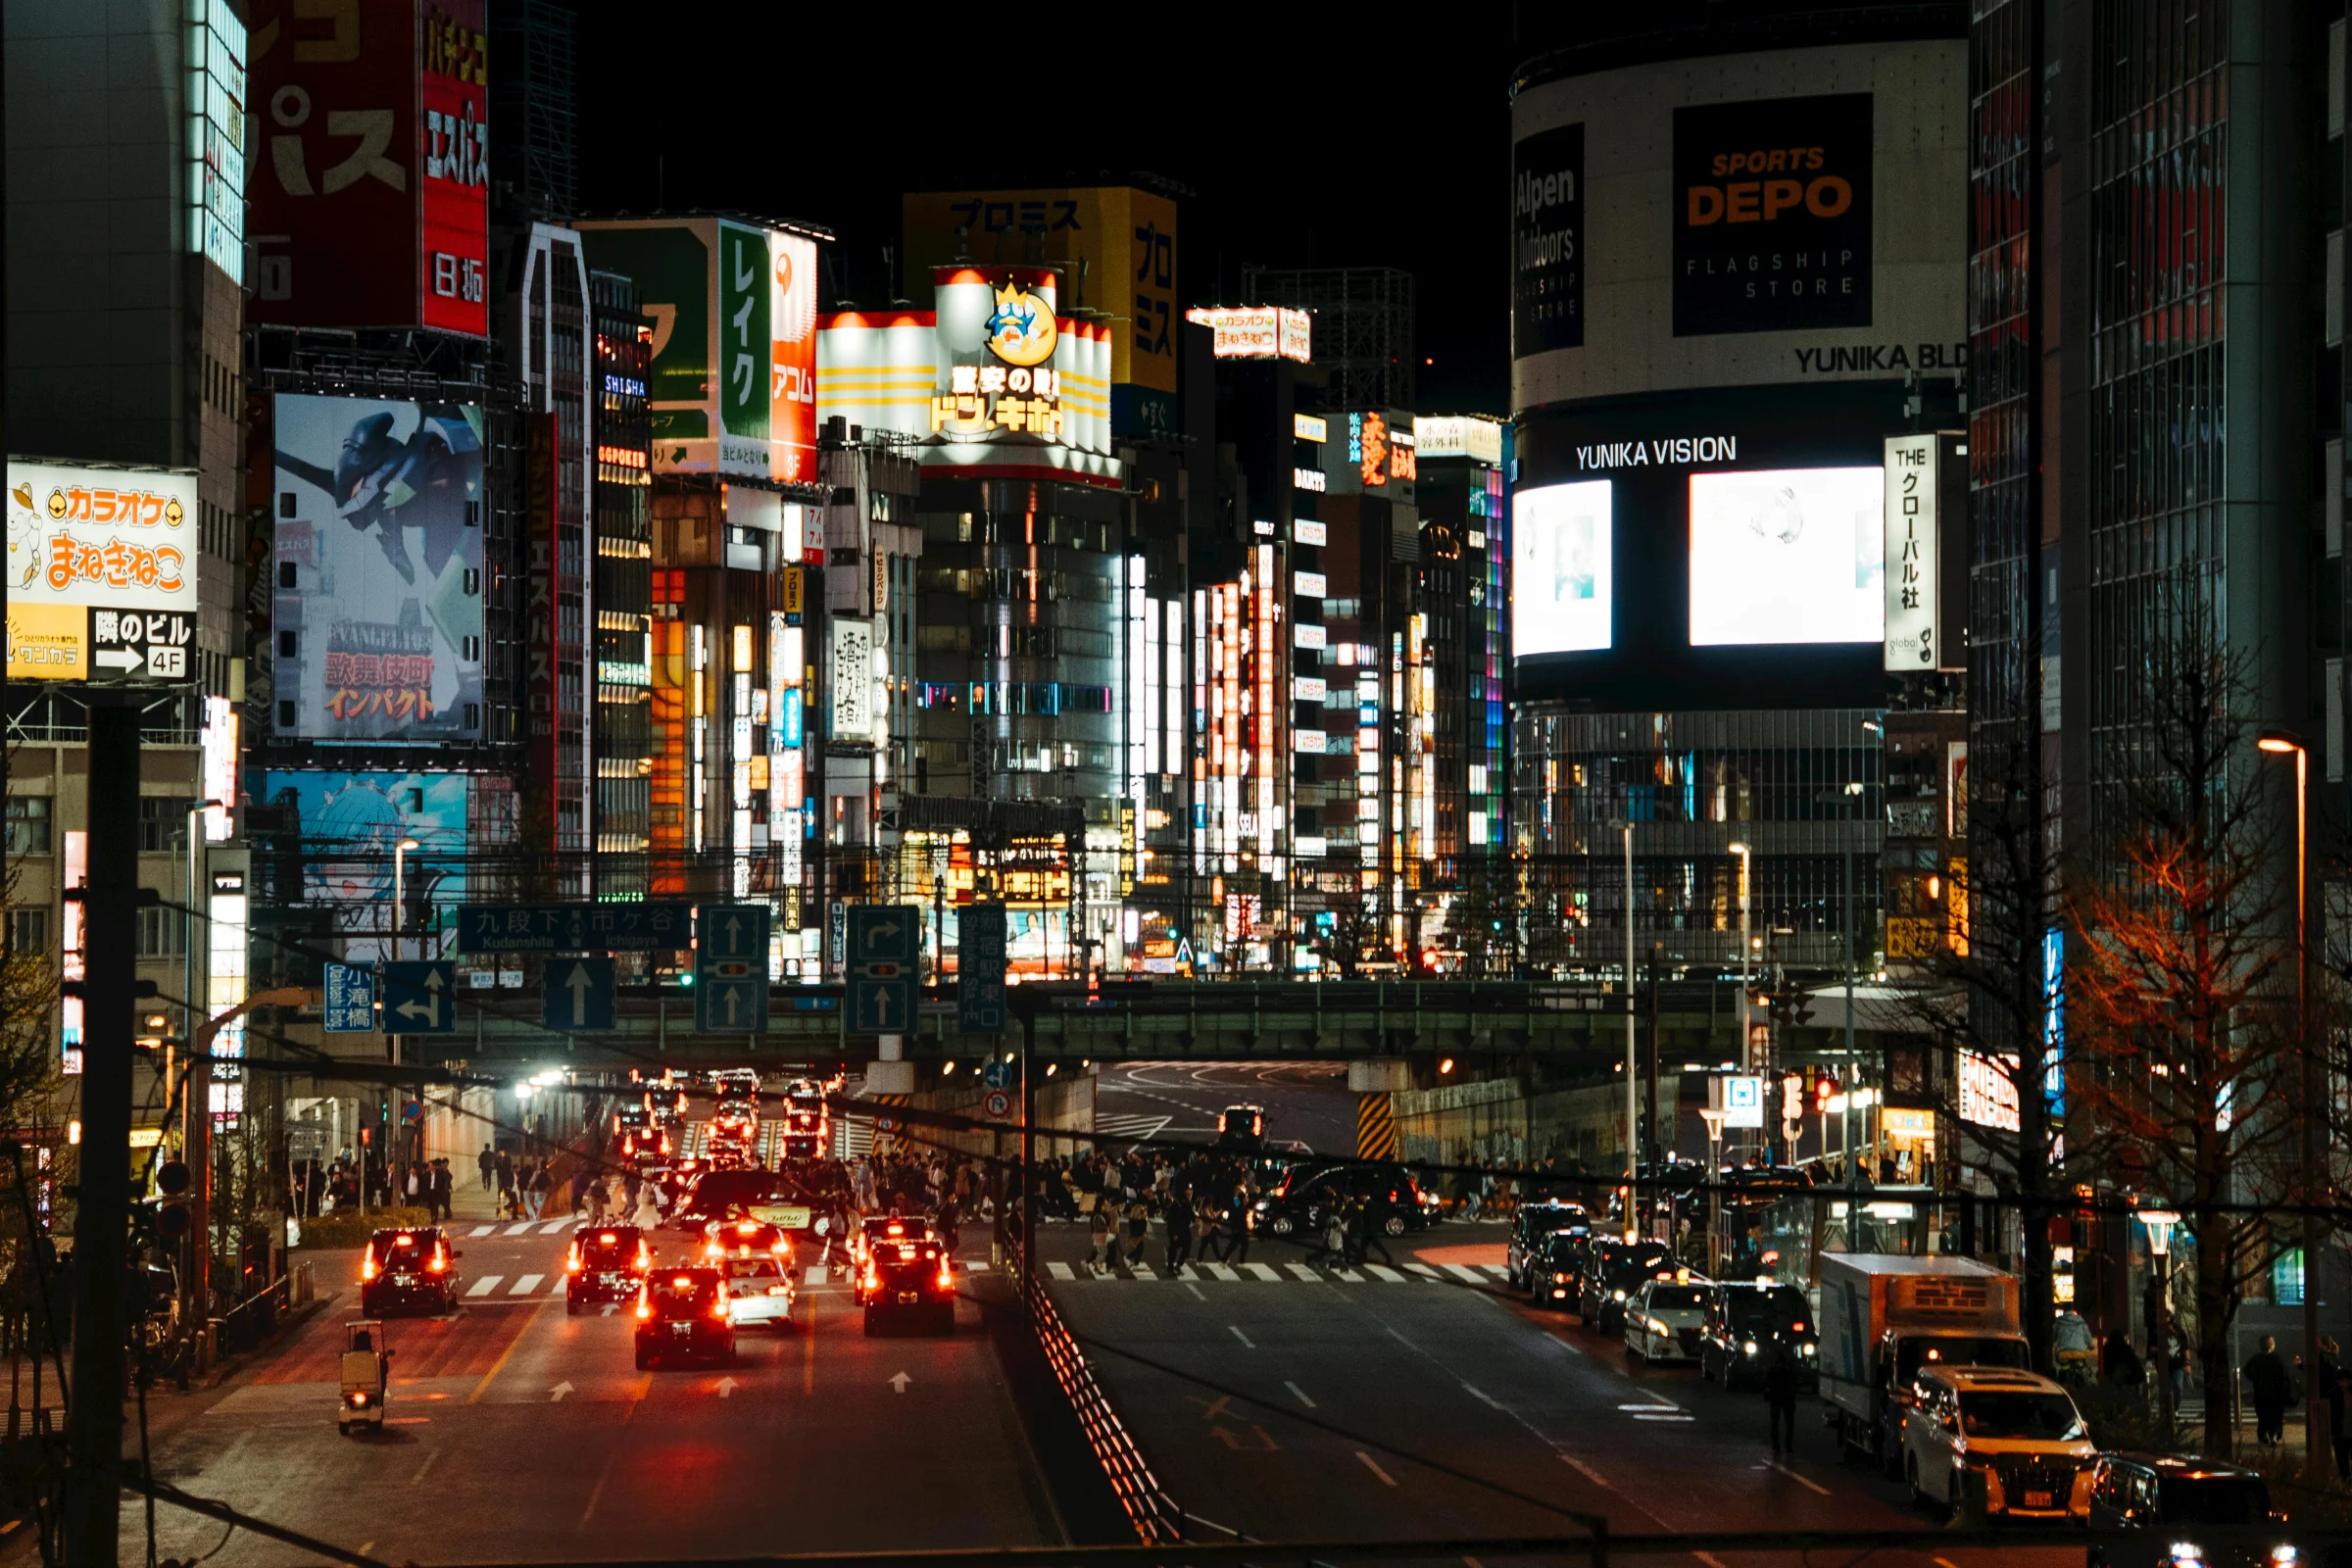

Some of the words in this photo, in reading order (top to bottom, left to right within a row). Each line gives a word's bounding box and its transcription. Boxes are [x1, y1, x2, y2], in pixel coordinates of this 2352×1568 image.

[427, 18, 488, 87] パチンコ
[427, 99, 488, 188] エスパス
[1711, 146, 1824, 177] SPORTS
[1517, 169, 1574, 222] Alpen
[1687, 175, 1853, 226] DEPO
[951, 198, 1082, 235] プロミス
[1519, 223, 1573, 272] Outdoors
[1687, 250, 1852, 276] FLAGSHIP
[1745, 277, 1852, 298] STORE
[733, 238, 755, 407] レイク
[1224, 315, 1265, 327] カラオケ
[1531, 299, 1575, 322] STORE
[1216, 330, 1273, 347] まねきねこ
[1794, 343, 1909, 373] YUNIKA
[605, 374, 645, 396] SHISHA
[773, 364, 812, 404] アコム
[598, 445, 647, 469] GGPOKER
[787, 455, 801, 477] 8F
[1576, 441, 1649, 470] YUNIKA
[1653, 435, 1738, 465] VISION
[1895, 448, 1927, 466] THE
[1294, 467, 1326, 492] DARTS
[65, 484, 168, 528] カラオケ
[1901, 470, 1921, 610] グローバル社
[47, 530, 183, 591] まねきねこ
[788, 571, 799, 610] プロミス
[94, 610, 191, 646] 隣のビル
[19, 645, 78, 664] ワンカラ
[152, 652, 182, 672] 4F
[1889, 636, 1919, 657] global
[324, 653, 434, 686] 歌舞伎町
[323, 687, 435, 722] インパクト
[475, 908, 562, 934] 九段下
[482, 935, 555, 950] Kudanshita
[606, 934, 660, 949] Ichigaya
[963, 913, 979, 973] Shinjuku
[980, 911, 1000, 1027] 新宿駅東口
[346, 968, 371, 1028] 小滝橋
